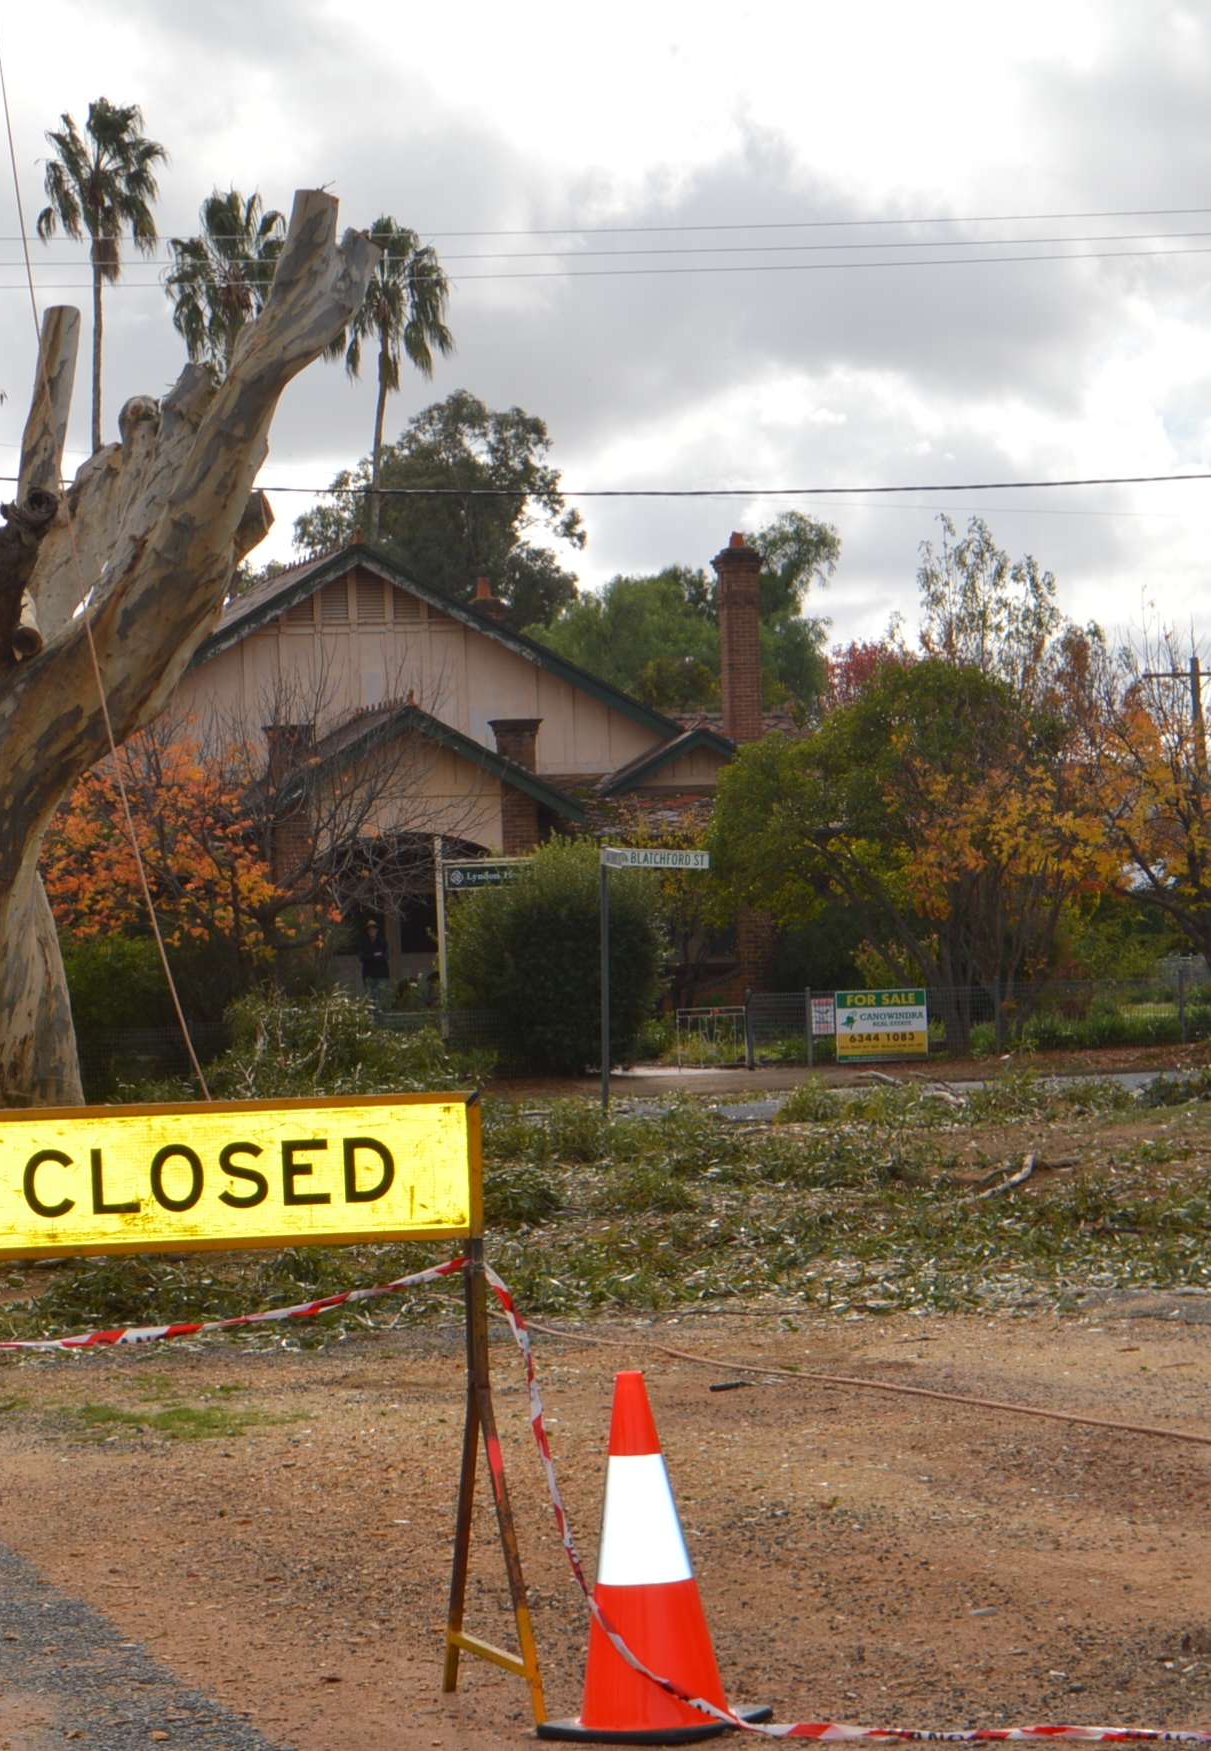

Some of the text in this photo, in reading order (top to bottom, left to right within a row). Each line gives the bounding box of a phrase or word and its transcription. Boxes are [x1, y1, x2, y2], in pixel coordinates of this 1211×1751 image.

[630, 851, 691, 866] BLATCHFORD
[693, 854, 705, 867] ST
[466, 871, 501, 882] Lyndon
[846, 994, 877, 1006] FOR
[881, 992, 916, 1005] SALE
[859, 1011, 924, 1021] CANOWINDRA
[849, 1032, 915, 1043] 6344 1083
[22, 1137, 396, 1217] CLOSED
